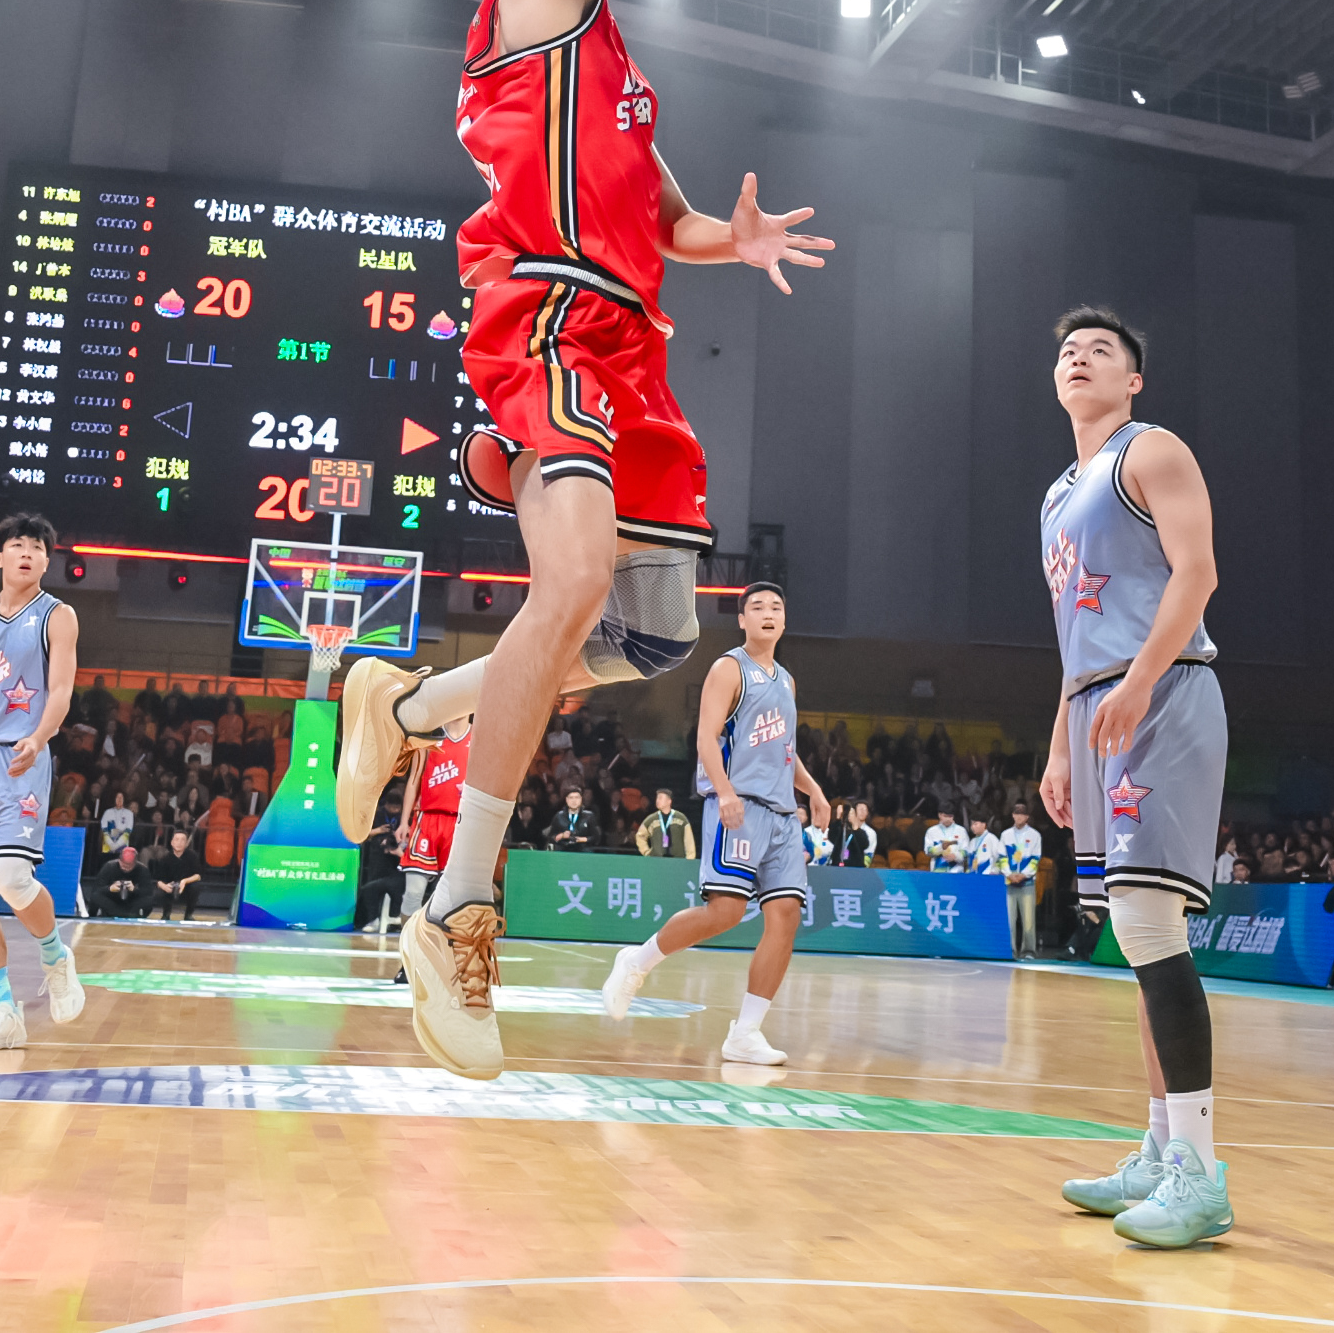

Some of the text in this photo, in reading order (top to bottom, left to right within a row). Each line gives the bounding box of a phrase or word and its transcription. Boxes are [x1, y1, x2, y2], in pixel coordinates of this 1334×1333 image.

[22, 186, 36, 198] 11
[146, 196, 156, 208] 2
[18, 210, 27, 221] 4
[142, 220, 152, 231] 0
[272, 205, 446, 240] 群众体育交流活动
[15, 235, 31, 247] 10
[140, 245, 150, 256] 0
[207, 236, 267, 259] 冠军队
[358, 248, 417, 271] 民星队
[12, 261, 28, 273] 14
[137, 271, 147, 282] 3
[134, 295, 144, 306] 0
[194, 277, 252, 318] 20
[363, 291, 415, 332] 15
[130, 322, 141, 332] 0
[460, 321, 470, 333] 2
[2, 336, 11, 348] 7
[128, 347, 138, 358] 4
[277, 338, 331, 362] 第1节
[125, 371, 135, 383] 0
[122, 398, 132, 409] 6
[454, 396, 464, 408] 7
[119, 425, 129, 436] 2
[249, 412, 339, 453] 2:34
[452, 422, 462, 434] 3
[116, 450, 126, 461] 0
[146, 456, 189, 480] 犯规
[312, 459, 372, 478] 02:33.7
[113, 476, 122, 488] 3
[319, 476, 361, 507] 20
[393, 474, 436, 498] 犯规
[157, 488, 170, 512] 1
[255, 476, 315, 522] 20
[402, 504, 420, 529] 2
[750, 670, 766, 684] 10
[754, 707, 782, 730] ALL
[748, 719, 787, 748] STAR
[428, 768, 459, 788] STAR
[432, 760, 456, 777] ALL
[420, 838, 429, 852] 9
[732, 838, 751, 861] 10
